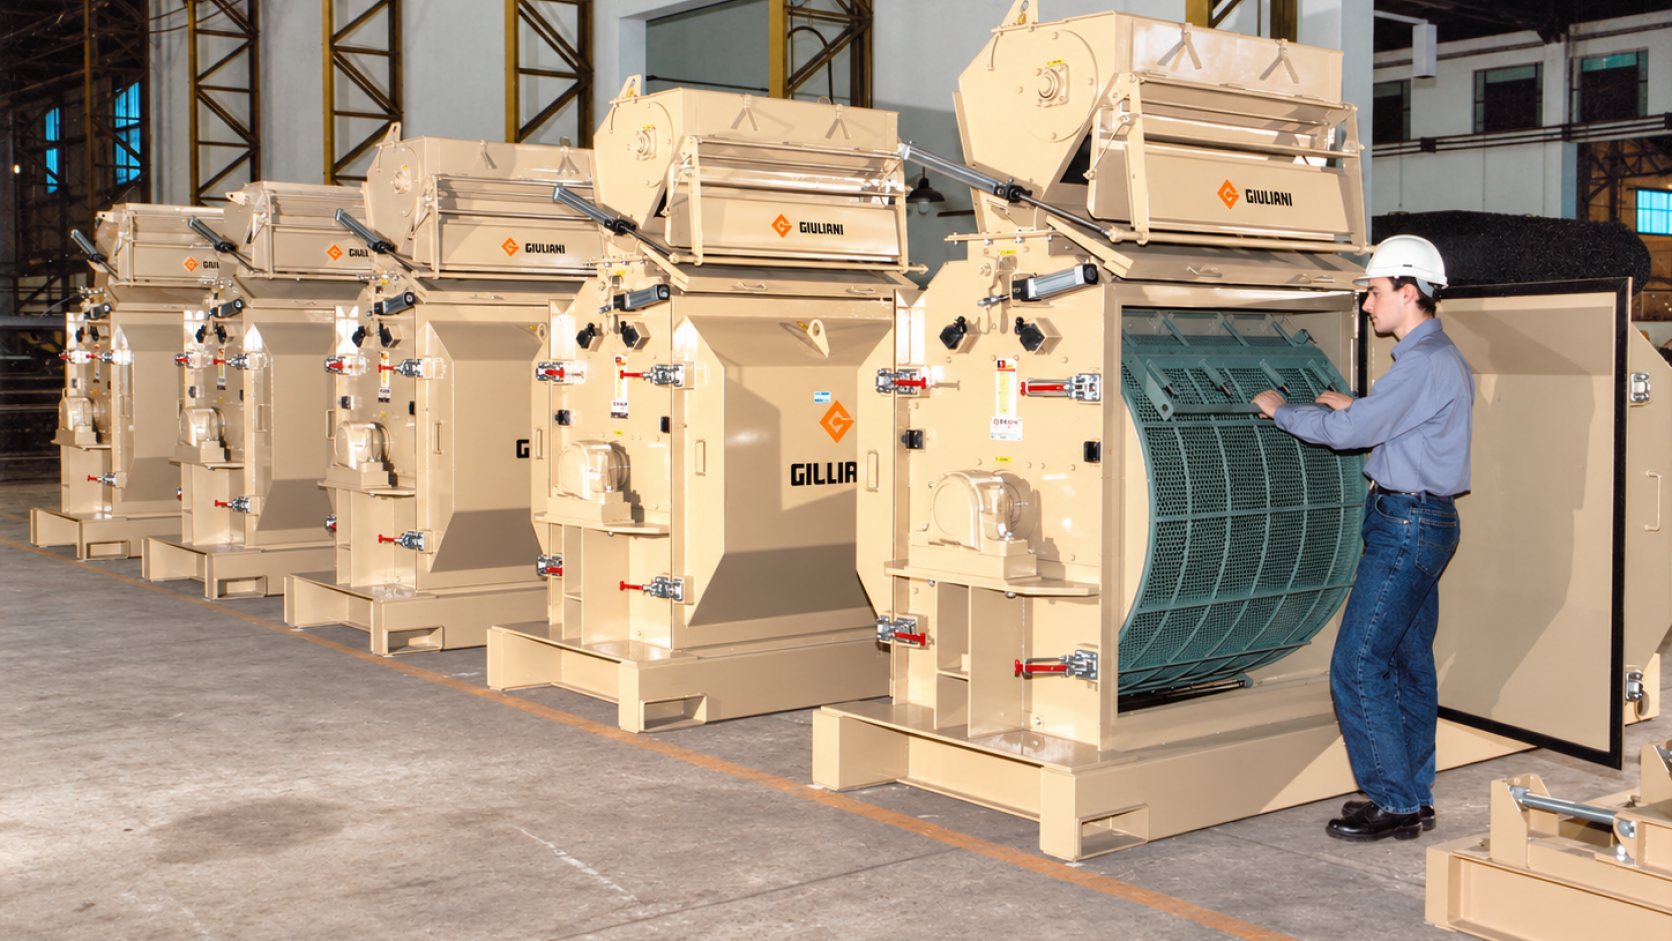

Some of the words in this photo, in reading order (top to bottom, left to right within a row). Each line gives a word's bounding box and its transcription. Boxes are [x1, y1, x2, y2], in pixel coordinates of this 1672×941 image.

[1245, 189, 1293, 207] GIULIANI
[799, 221, 844, 235] GIULIANI
[525, 243, 565, 254] GIULIANI
